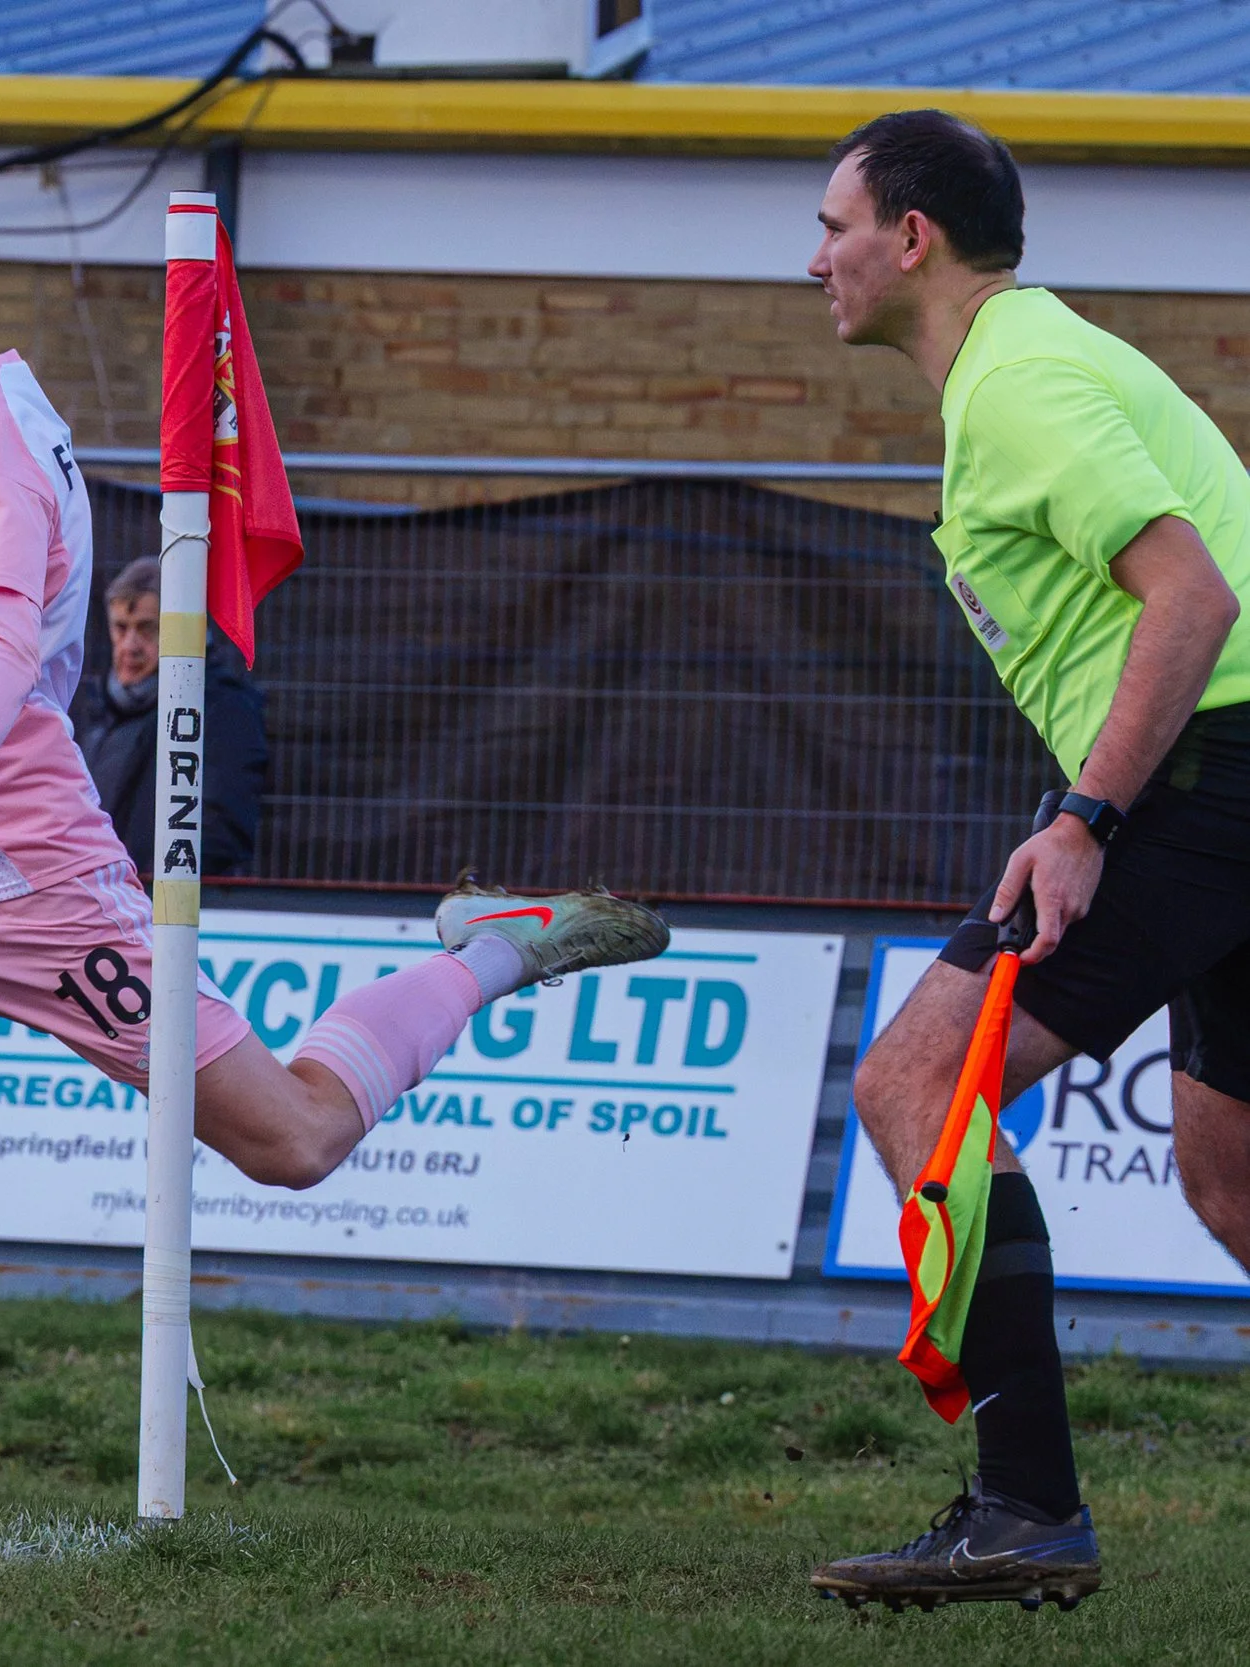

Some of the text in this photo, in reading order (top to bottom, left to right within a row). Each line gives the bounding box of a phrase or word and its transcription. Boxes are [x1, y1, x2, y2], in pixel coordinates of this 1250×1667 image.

[54, 946, 151, 1041] 18
[568, 975, 748, 1068] LTD
[511, 1096, 575, 1131] OF
[587, 1101, 728, 1139] SPOIL
[342, 1146, 415, 1174] HU10
[423, 1149, 482, 1177] 6RJ
